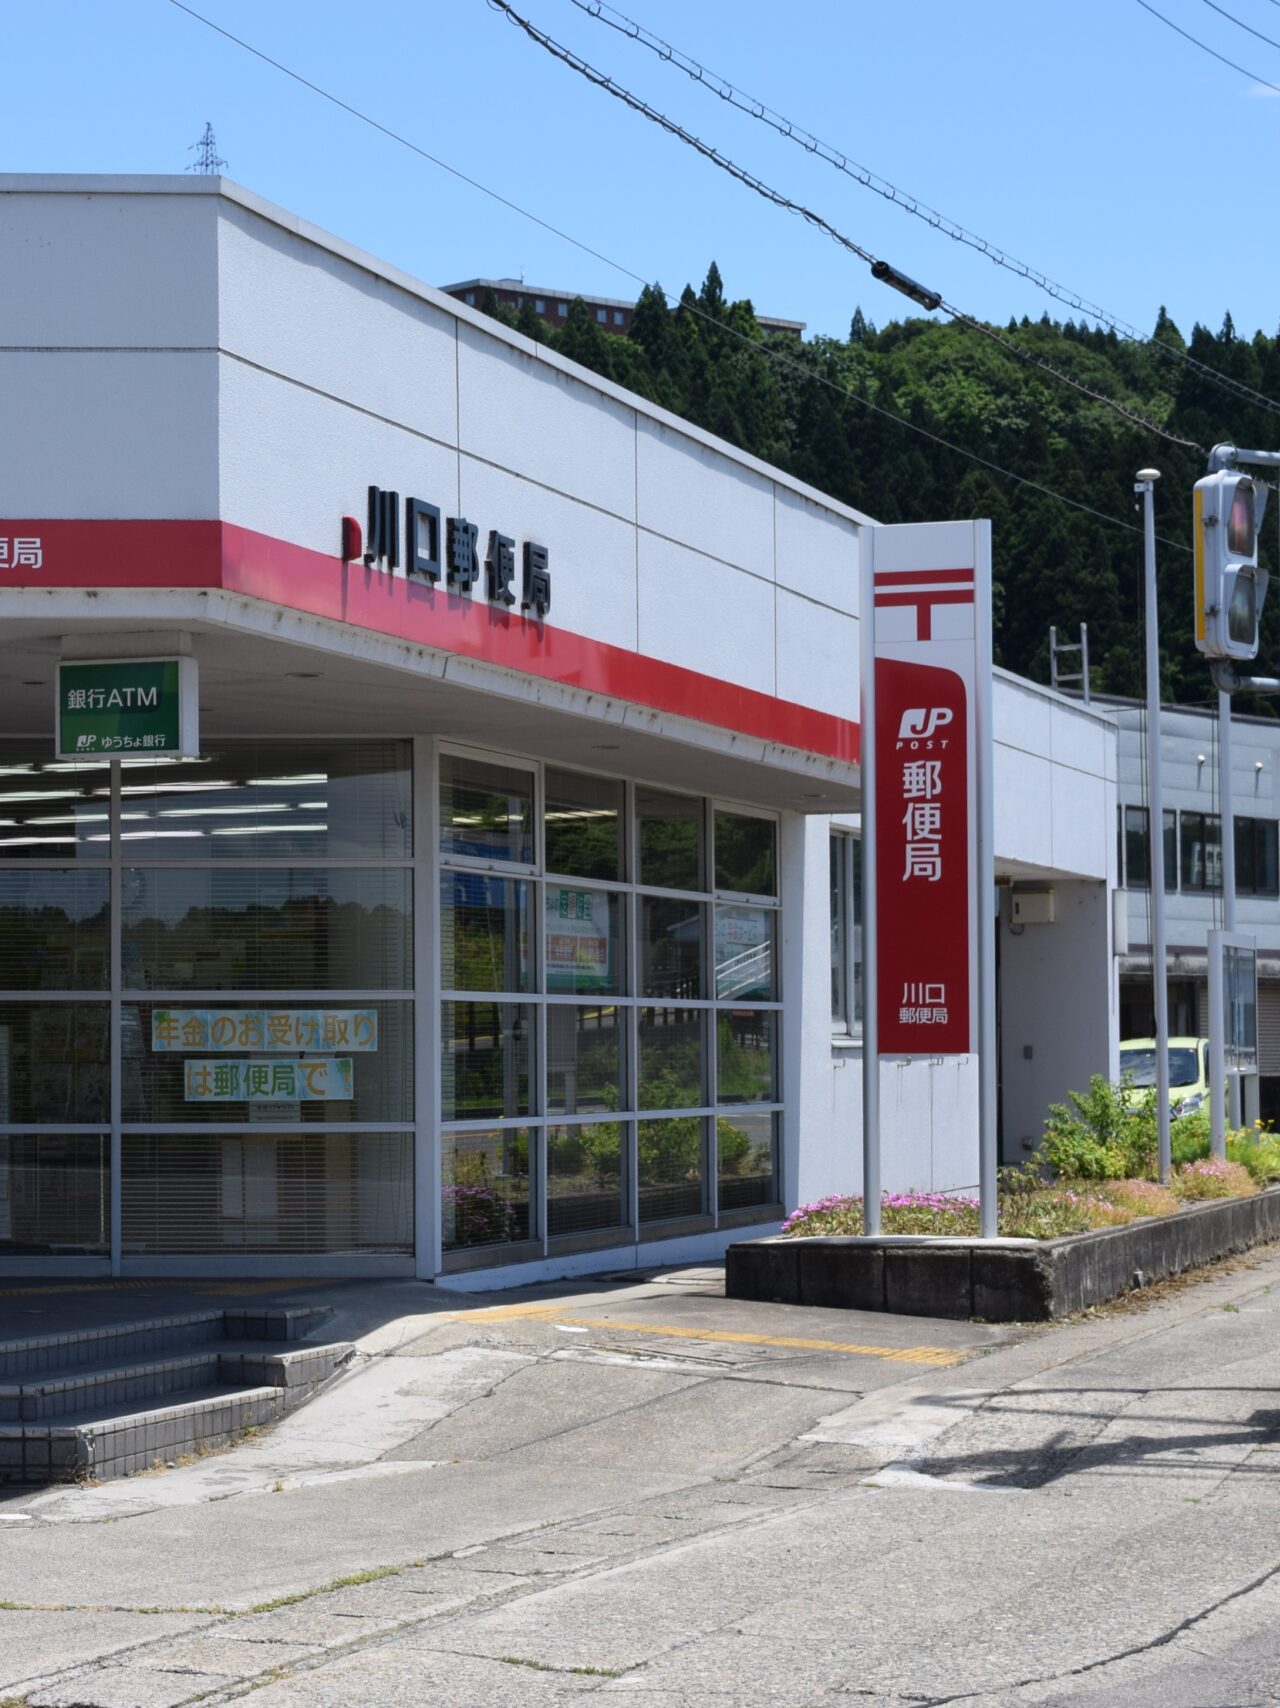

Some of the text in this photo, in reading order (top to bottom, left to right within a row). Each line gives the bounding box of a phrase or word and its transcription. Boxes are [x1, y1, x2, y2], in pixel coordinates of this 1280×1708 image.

[364, 485, 551, 614] 川口郵便局
[67, 686, 158, 709] 銀行ATM
[898, 707, 954, 739] JP
[101, 734, 166, 749] ゆうちょ銀行
[896, 740, 948, 750] POST
[902, 760, 942, 882] 郵便局
[902, 982, 945, 1005] 川口
[899, 1007, 948, 1024] 郵便局
[155, 1014, 375, 1048] 年金のお受け取り
